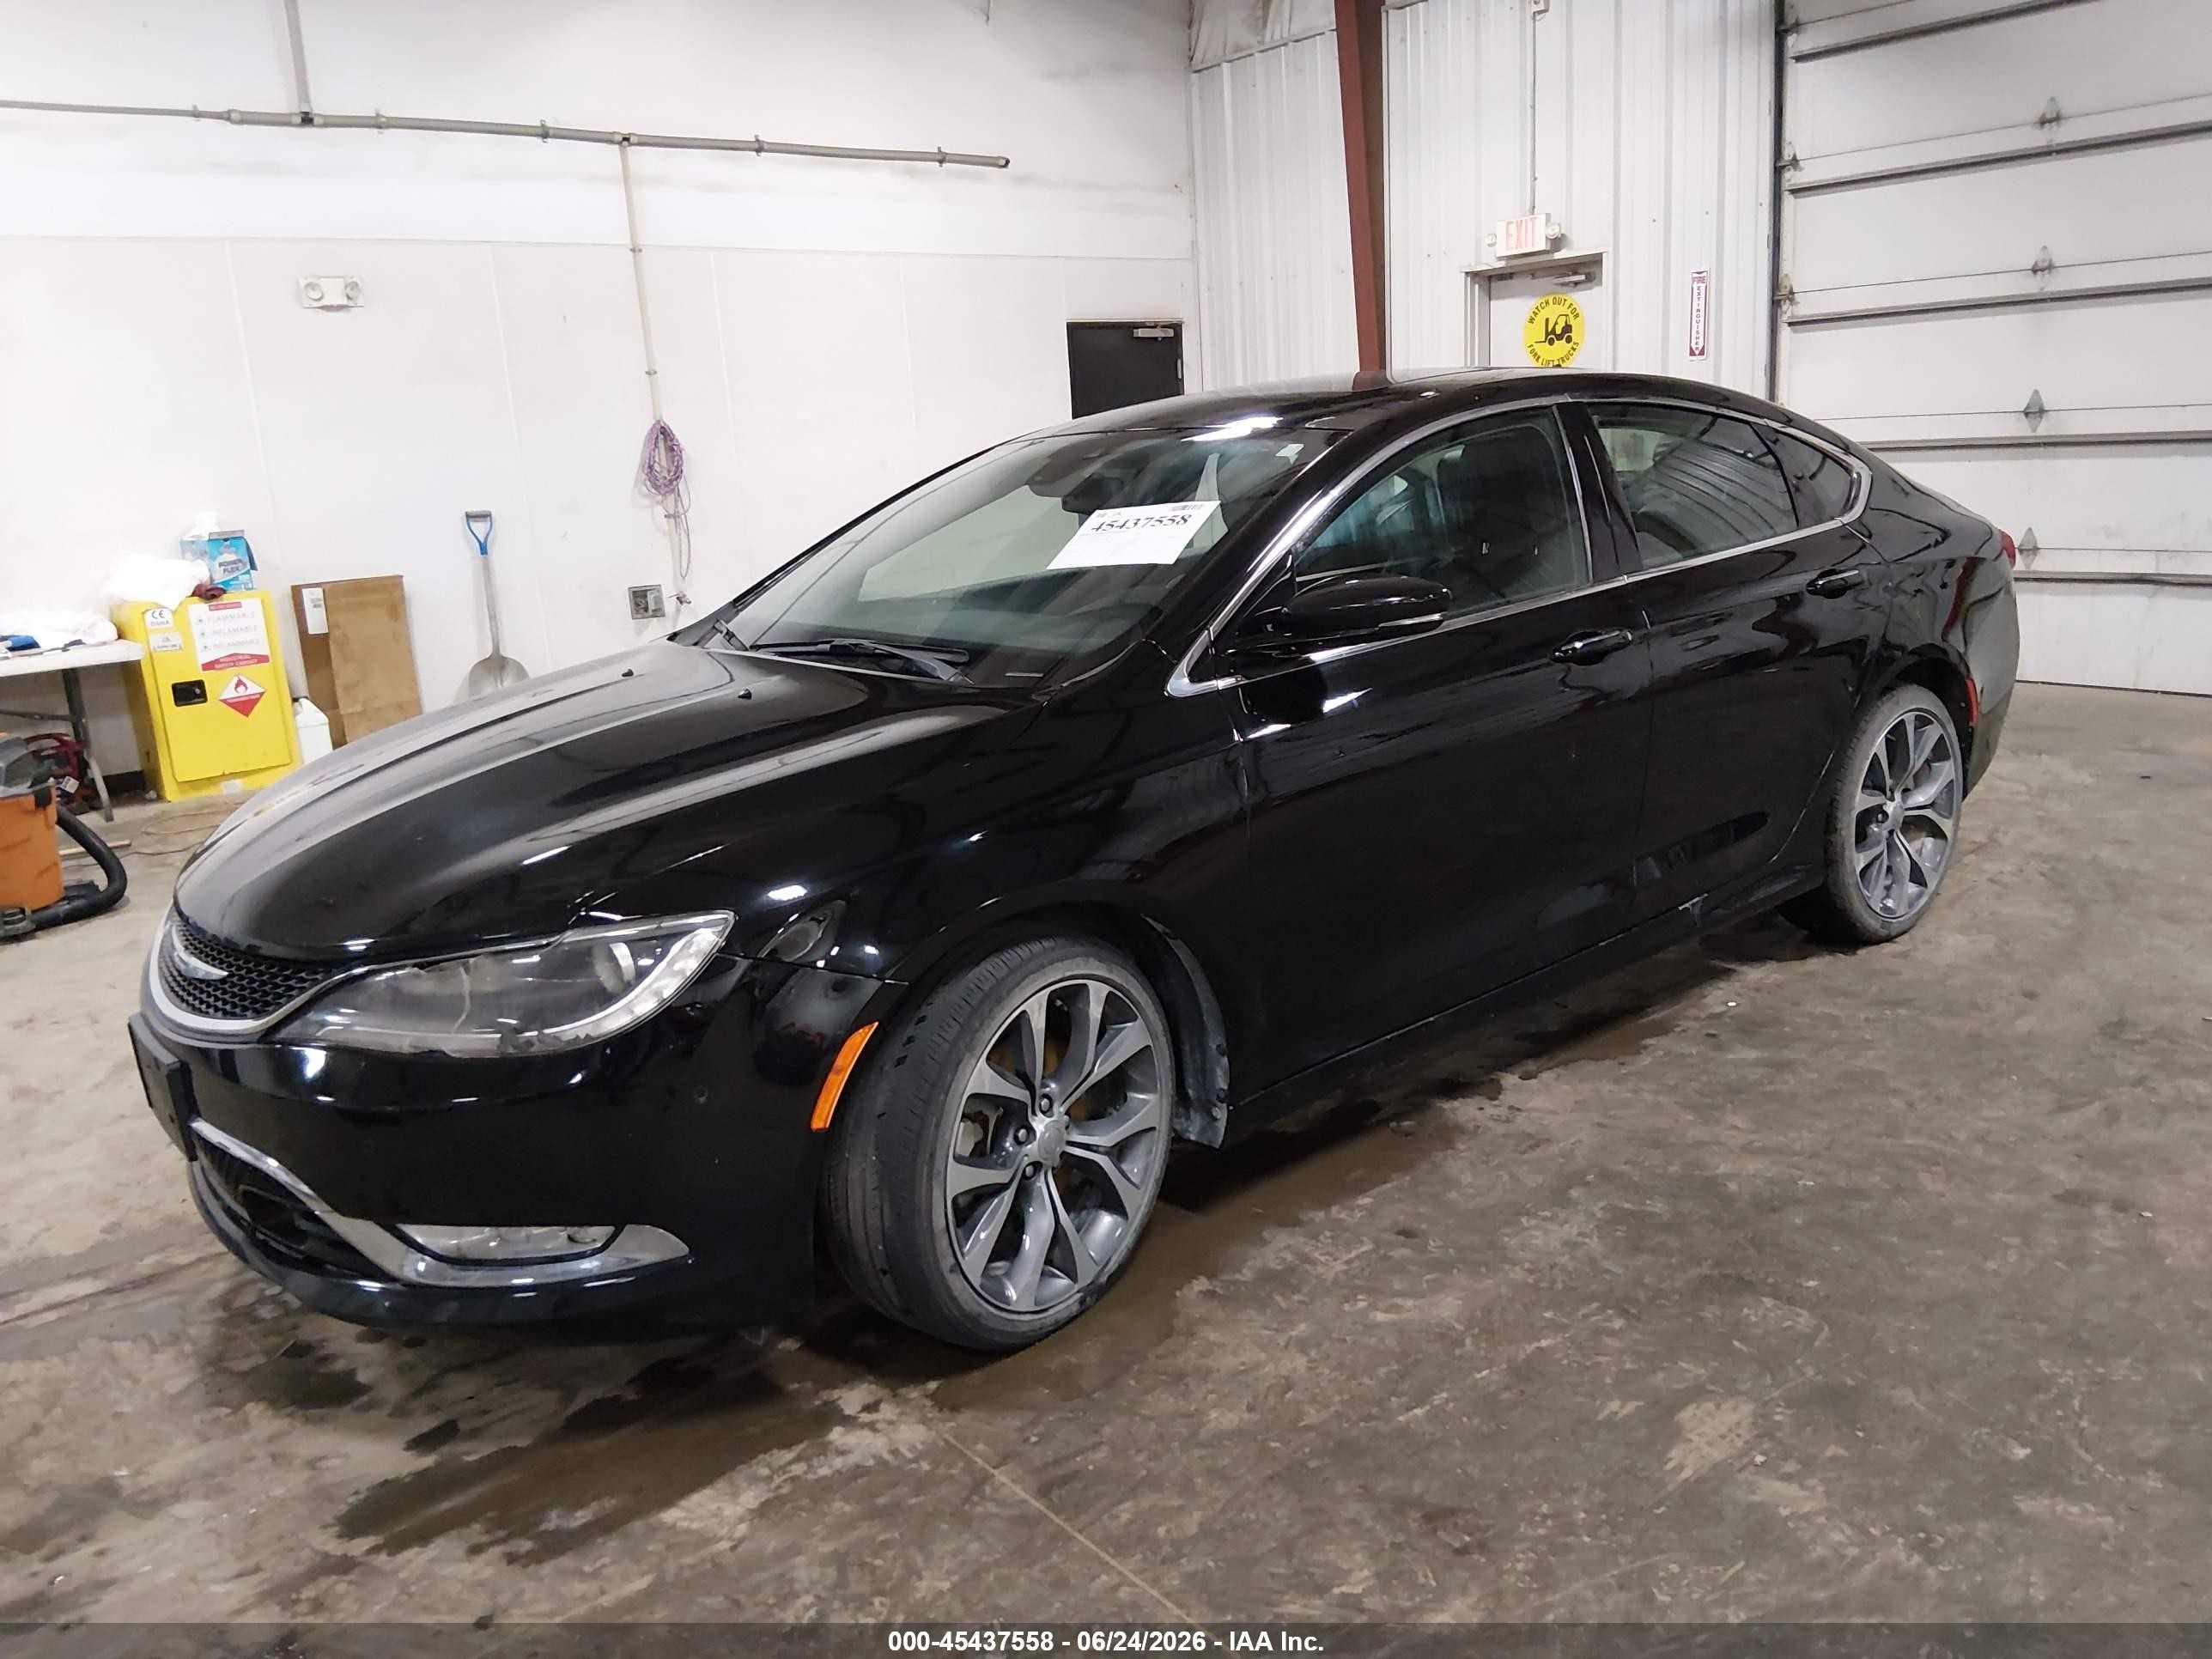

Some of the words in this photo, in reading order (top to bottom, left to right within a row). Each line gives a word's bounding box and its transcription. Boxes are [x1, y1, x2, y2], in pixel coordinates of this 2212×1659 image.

[1505, 216, 1538, 251] EXIT
[1528, 298, 1550, 325] WATCH
[1553, 296, 1567, 307] OUT
[1567, 302, 1580, 320] FOR
[1528, 344, 1541, 362] FORK
[1540, 359, 1555, 368] LIFT
[1557, 341, 1579, 366] TRUCKS
[1091, 514, 1193, 532] 45437558
